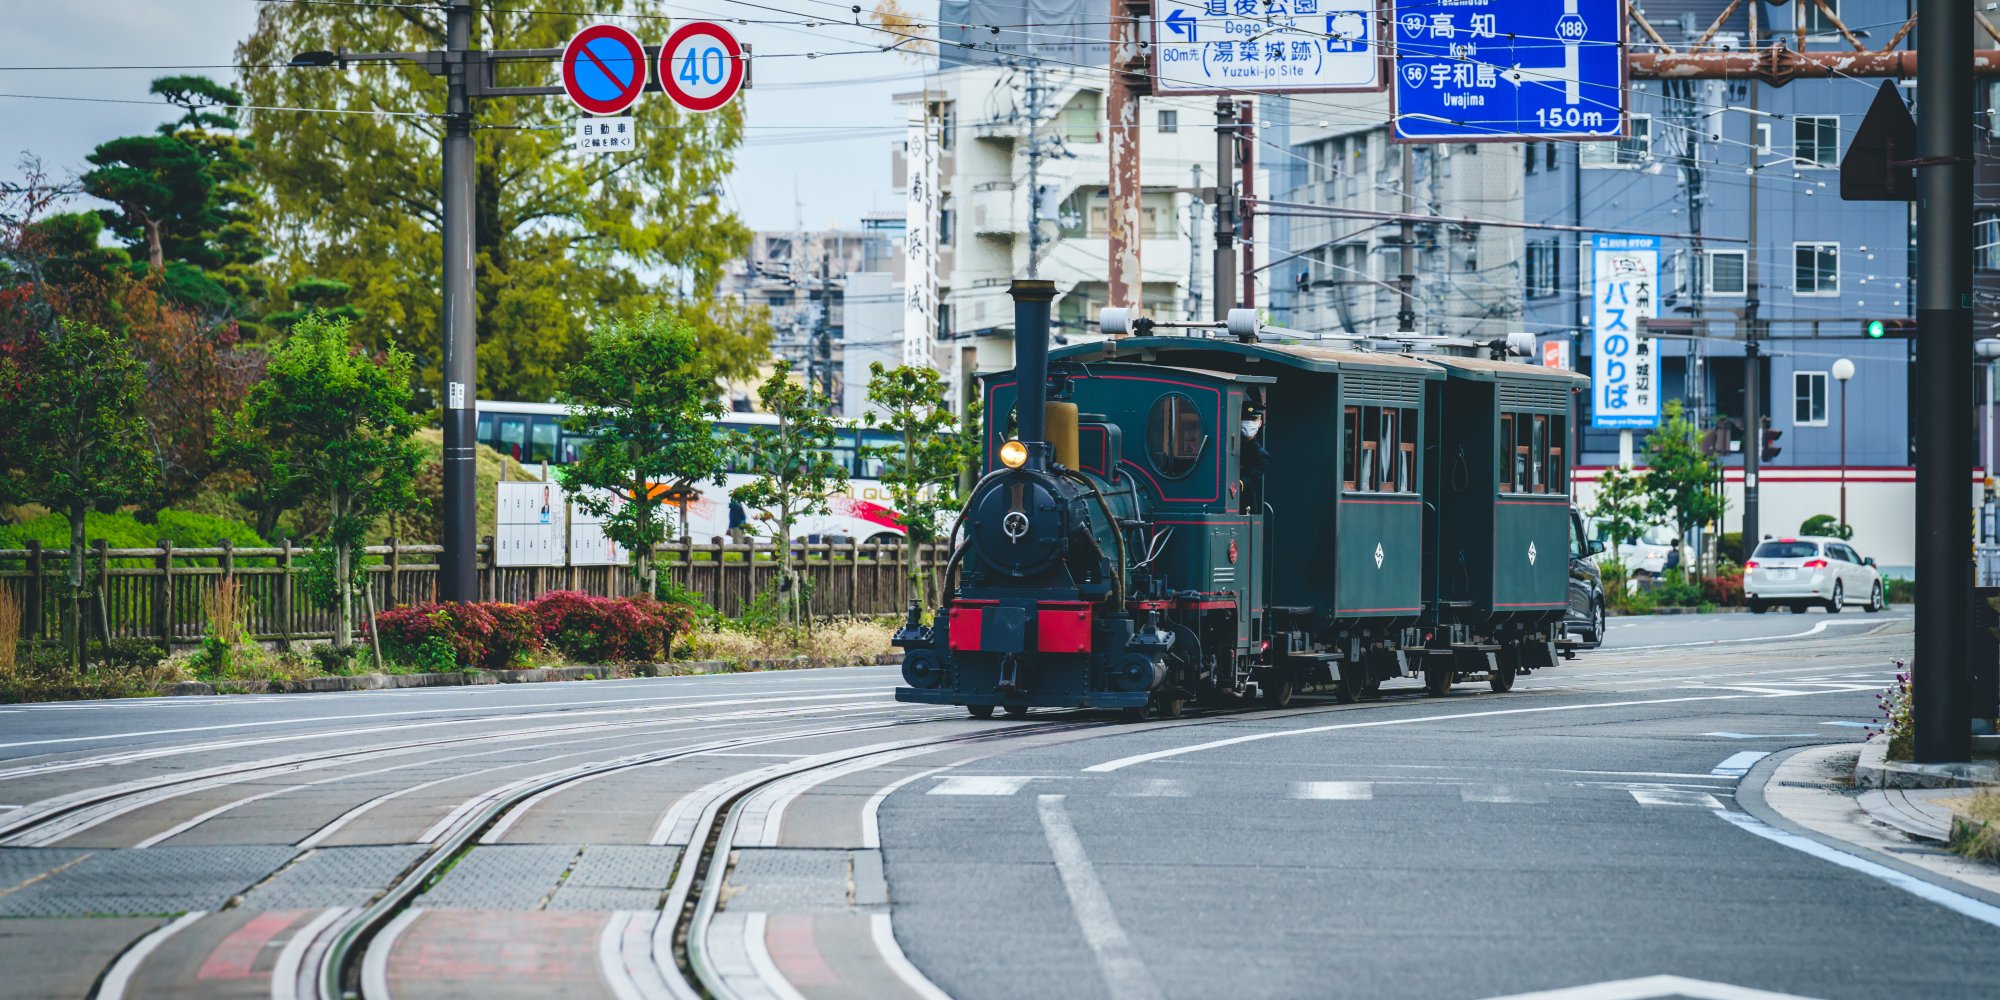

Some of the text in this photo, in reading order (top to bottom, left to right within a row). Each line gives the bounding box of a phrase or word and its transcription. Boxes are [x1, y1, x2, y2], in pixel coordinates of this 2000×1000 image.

[1225, 21, 1261, 37] Dogo
[1407, 17, 1421, 30] 33
[1430, 12, 1496, 39] 高知
[1560, 21, 1583, 37] 188
[1163, 48, 1200, 62] 80m先
[1450, 42, 1477, 57] Kochi
[679, 47, 724, 86] 40
[1222, 65, 1304, 79] Yuzuki-jo Site
[1408, 67, 1423, 81] 56
[1430, 62, 1497, 90] 宇和島
[1443, 92, 1485, 110] Uwajima
[1536, 108, 1603, 127] 150m
[584, 122, 627, 135] 自動車
[1628, 238, 1653, 247] STOP
[1604, 281, 1631, 409] バスのりば
